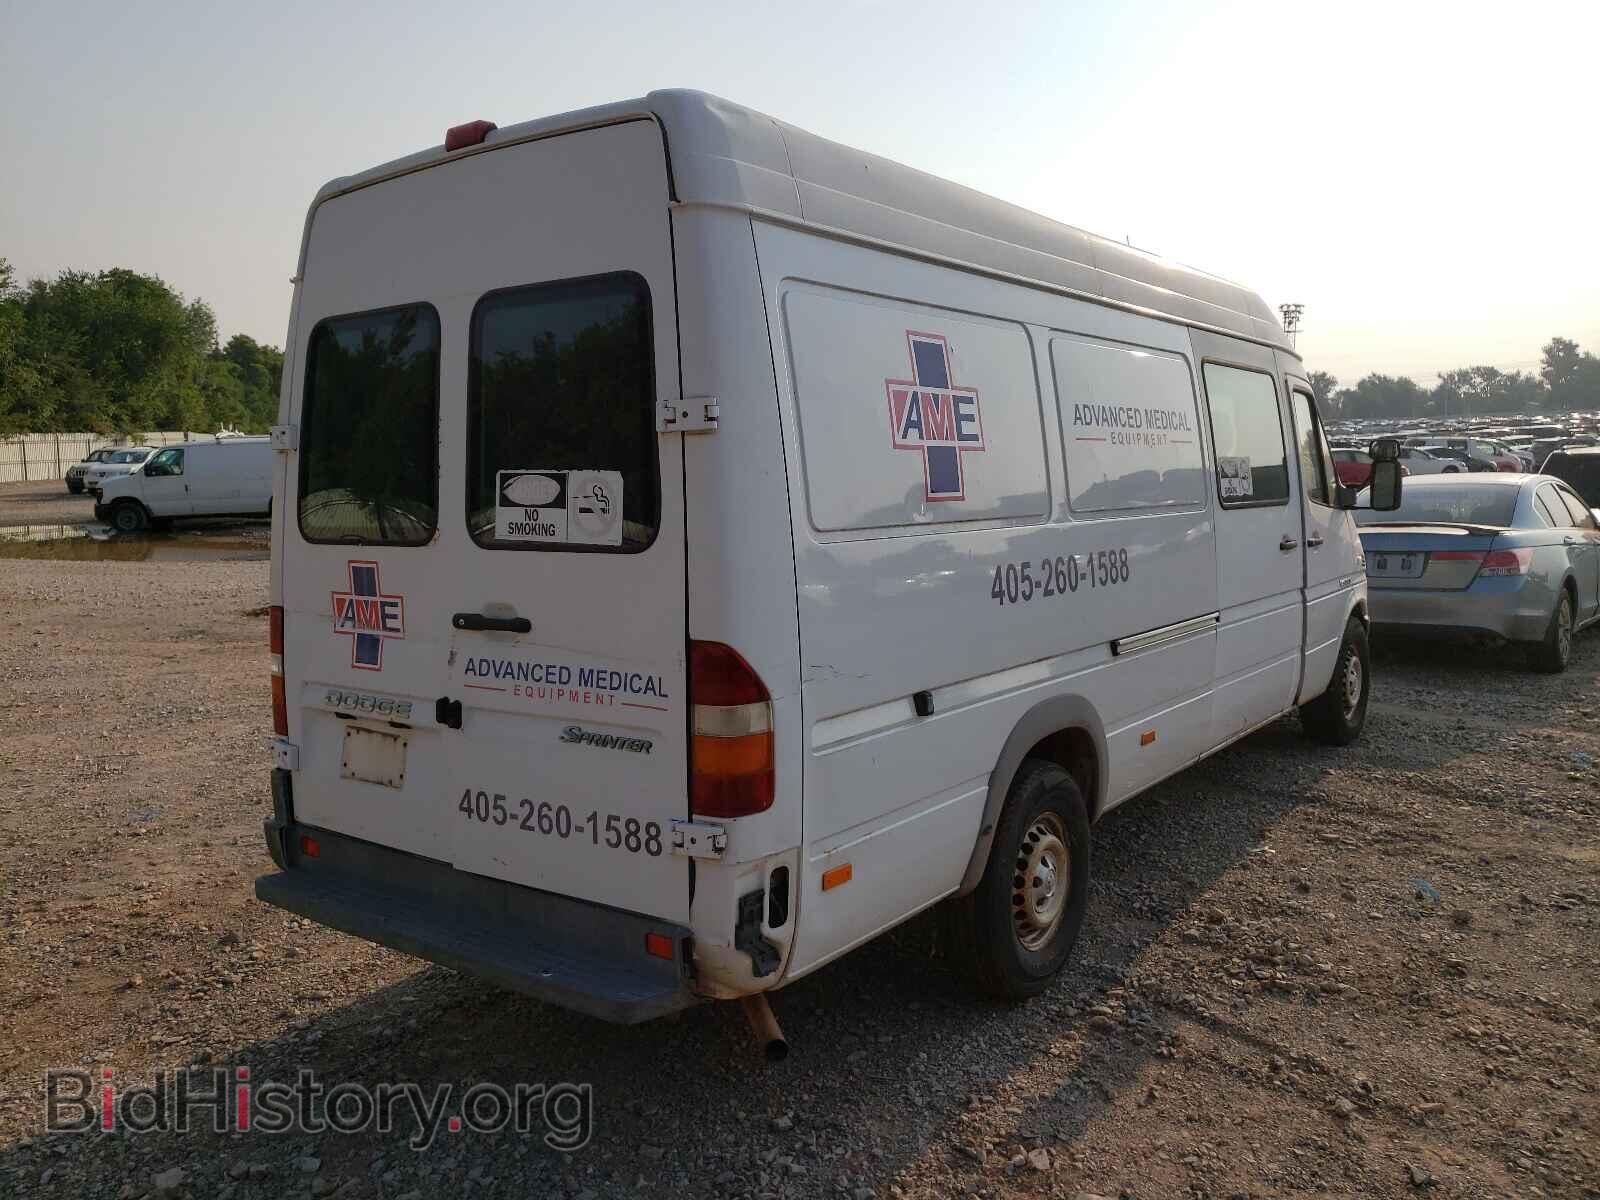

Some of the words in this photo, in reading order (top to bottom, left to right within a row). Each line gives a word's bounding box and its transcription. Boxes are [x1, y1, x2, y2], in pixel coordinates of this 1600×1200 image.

[900, 391, 980, 441] AME
[1073, 403, 1142, 428] ADVANCED
[1144, 408, 1191, 431] MEDICAL
[1111, 431, 1168, 448] EQUIPMENT
[508, 521, 556, 537] SMOKING
[524, 508, 539, 522] NO
[991, 548, 1130, 606] 405-260-1588
[340, 598, 402, 633] AME
[464, 657, 571, 685] ADVANCED
[578, 667, 669, 698] MEDICAL
[513, 684, 616, 706] EQUIPMENT
[458, 788, 663, 857] 405-260-1588
